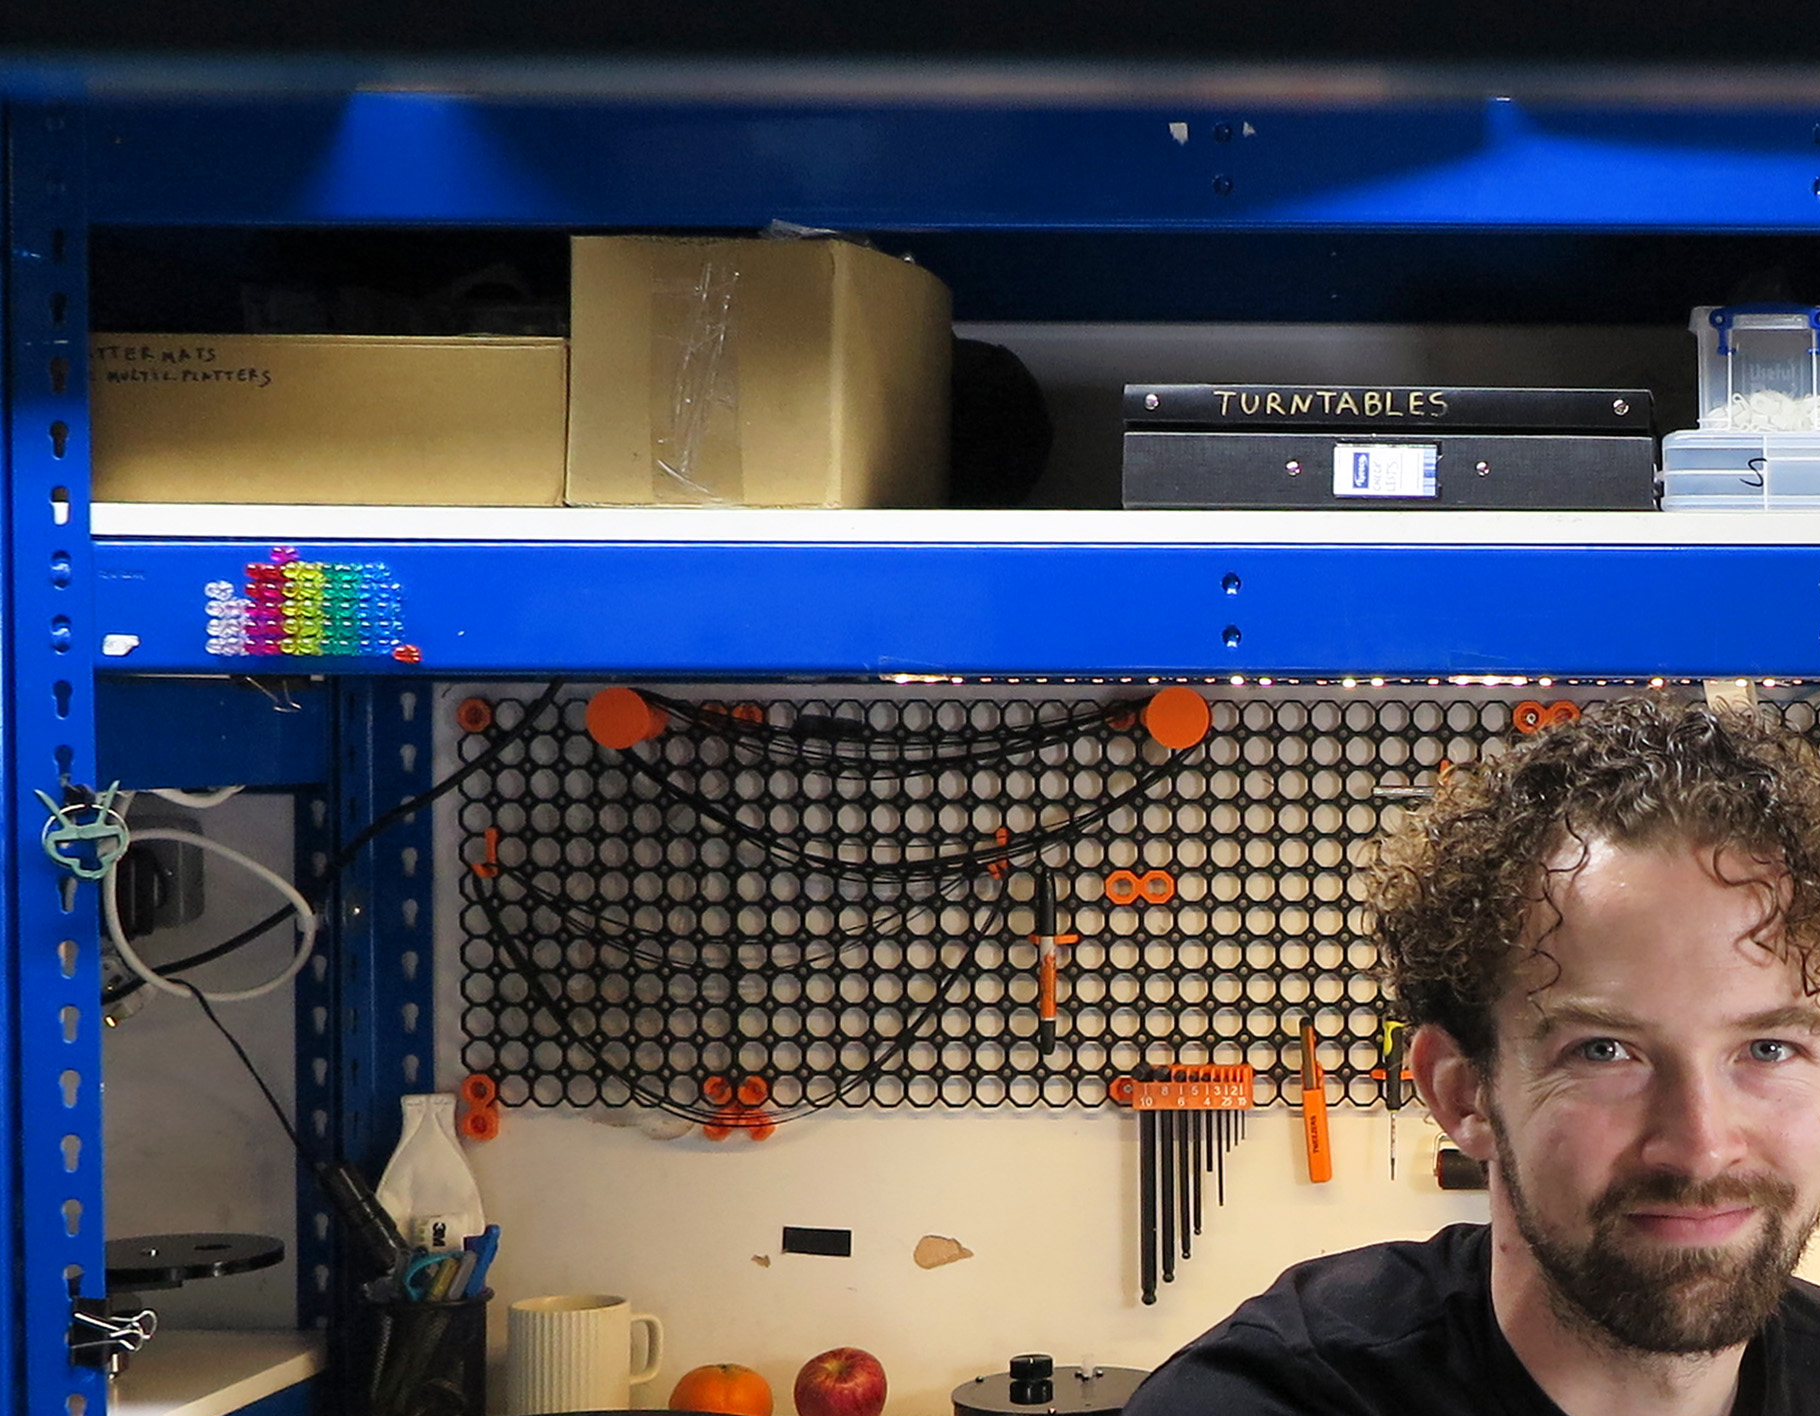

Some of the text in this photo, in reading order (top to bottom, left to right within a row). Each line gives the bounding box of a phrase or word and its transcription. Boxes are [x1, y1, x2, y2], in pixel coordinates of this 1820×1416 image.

[182, 369, 273, 388] PLATTERS
[1213, 390, 1449, 417] TURNTABLES
[1738, 457, 1768, 488] S
[1140, 1096, 1153, 1107] 10
[1203, 1097, 1211, 1107] 4
[432, 1221, 447, 1248] 3M
